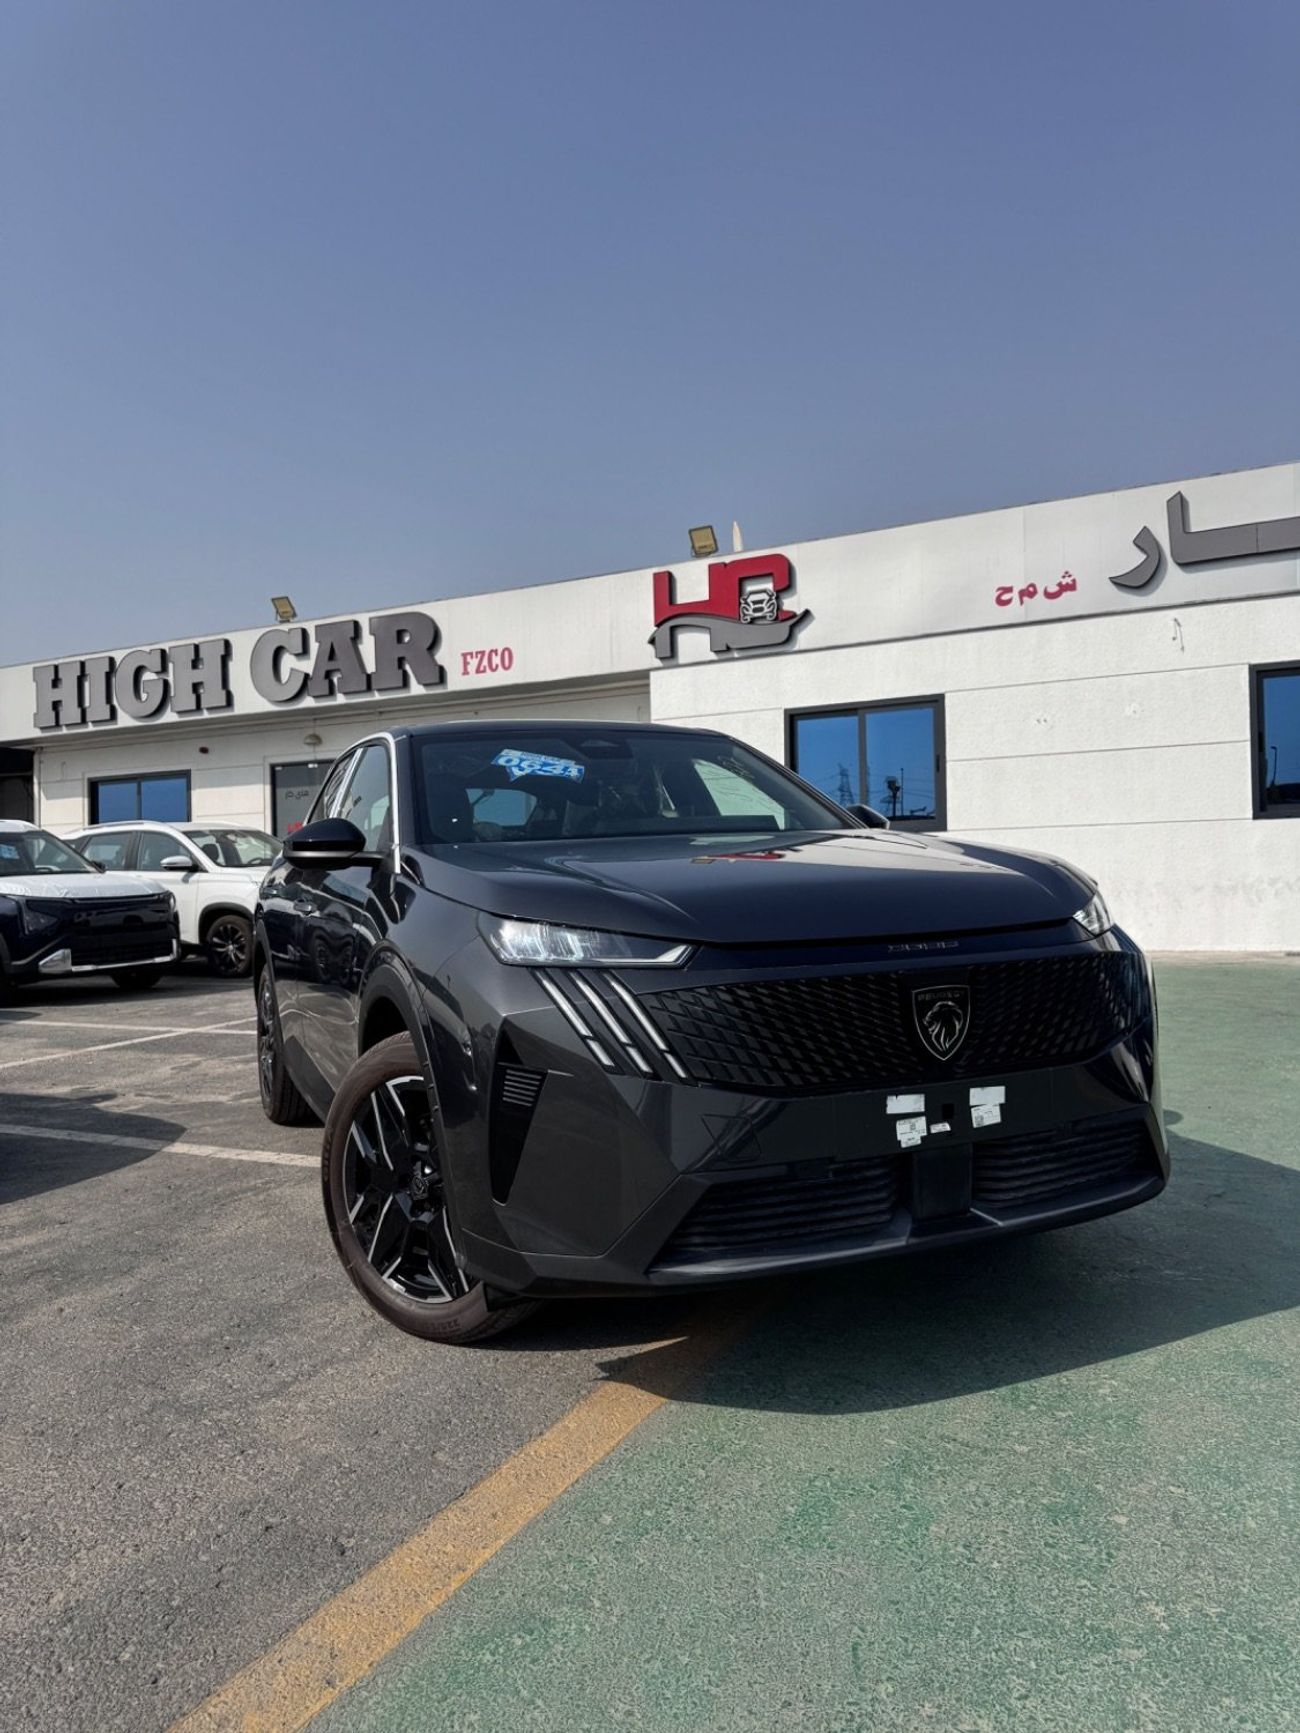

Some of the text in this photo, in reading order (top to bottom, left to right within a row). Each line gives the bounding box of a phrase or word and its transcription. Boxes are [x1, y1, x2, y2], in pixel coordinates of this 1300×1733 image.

[1109, 491, 1300, 588] ار
[33, 612, 513, 728] HIGH CAR FZCO
